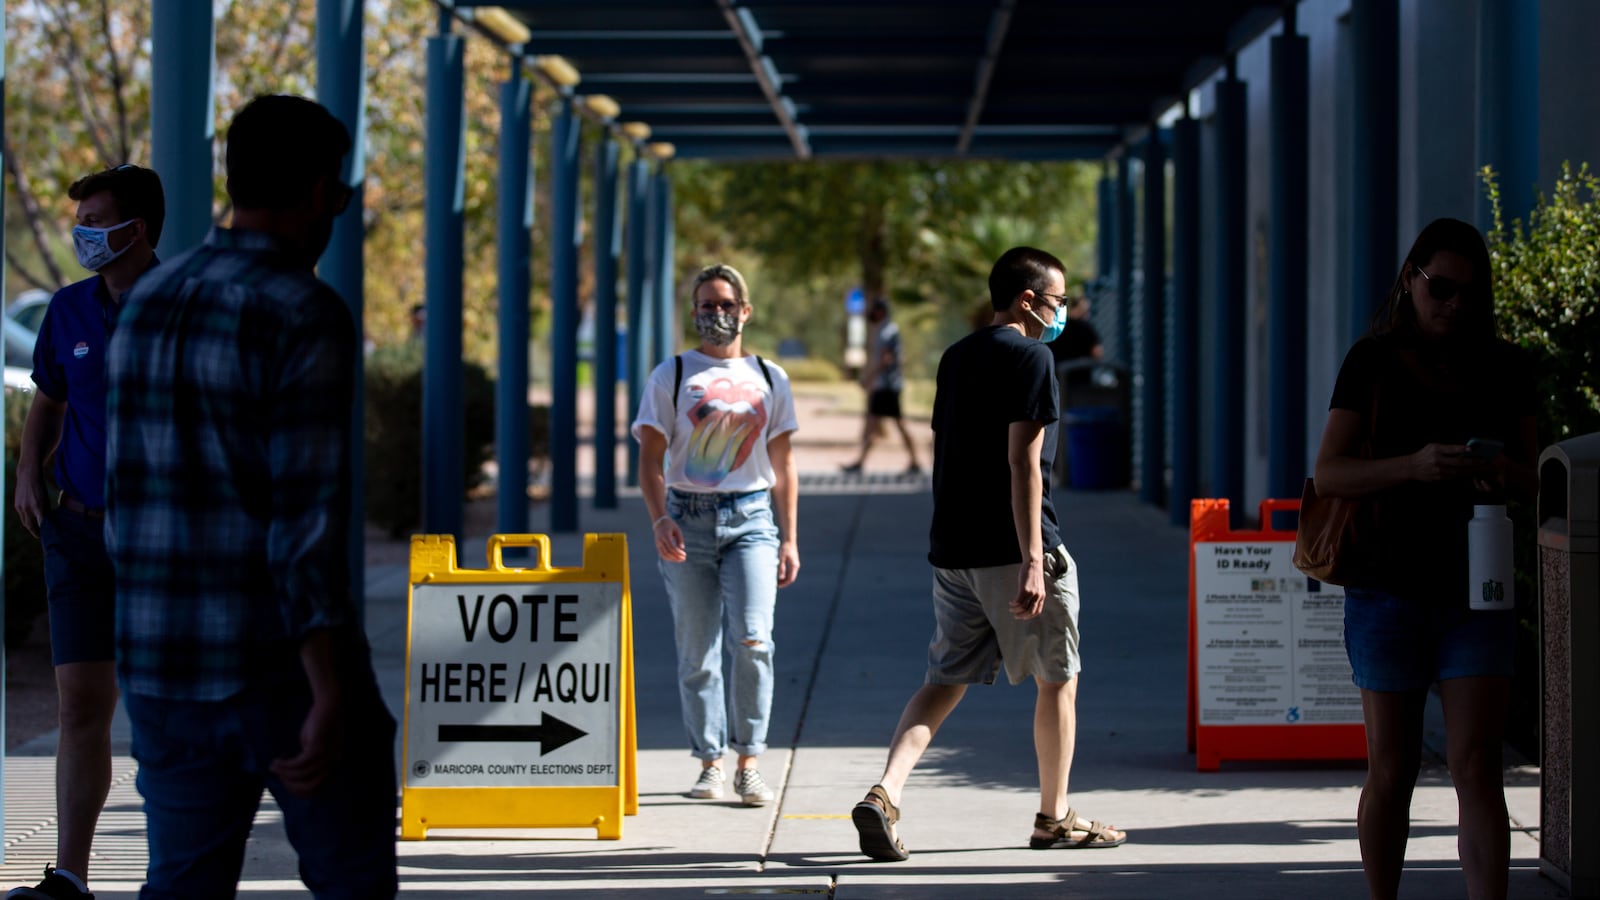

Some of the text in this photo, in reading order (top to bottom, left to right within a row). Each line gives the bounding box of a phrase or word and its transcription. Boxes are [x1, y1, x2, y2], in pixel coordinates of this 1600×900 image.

[1215, 545, 1273, 555] Have Your
[1217, 558, 1271, 572] ID Ready
[457, 593, 579, 644] VOTE
[421, 662, 507, 703] HERE
[533, 662, 611, 704] AQUI
[434, 764, 485, 775] MARICOPA
[487, 764, 527, 775] COUNTY
[530, 764, 584, 775] ELECTIONS
[586, 764, 614, 775] DEPT.
